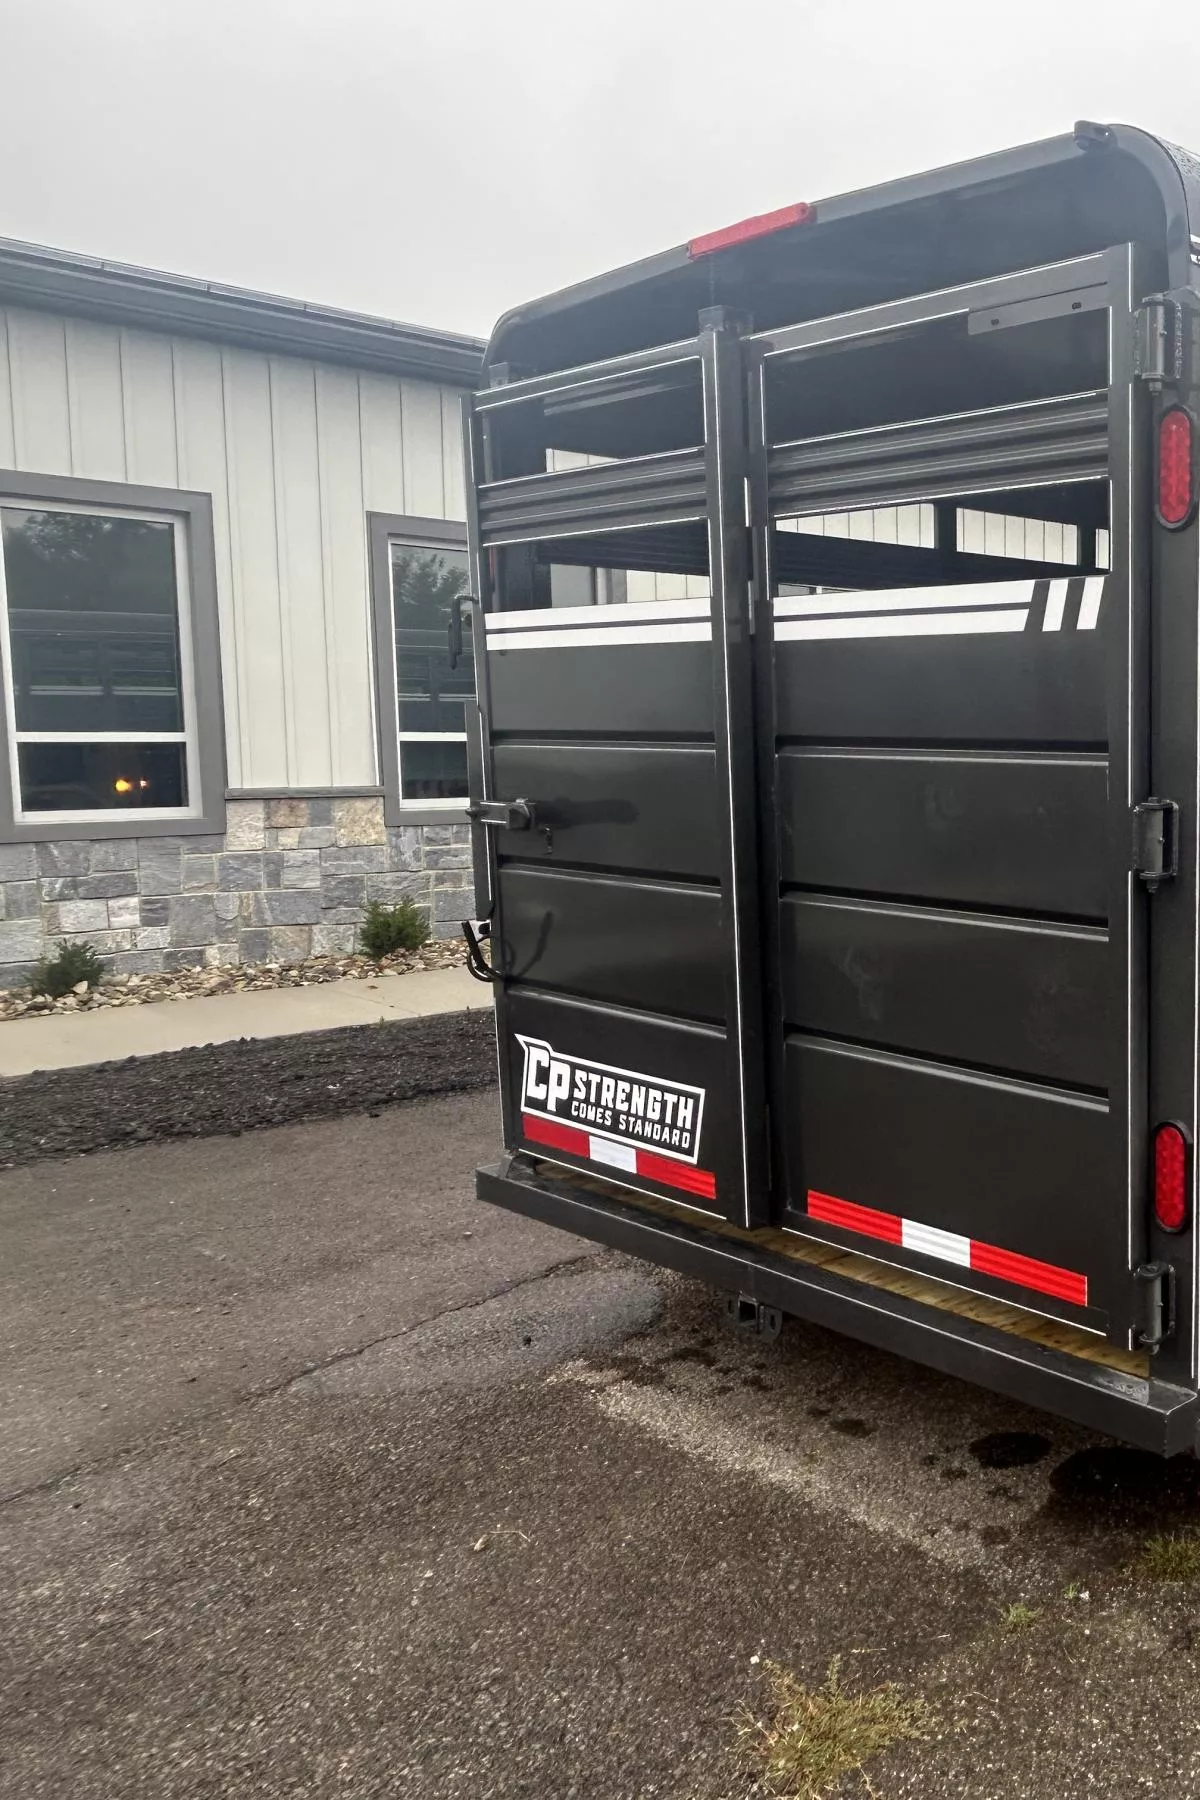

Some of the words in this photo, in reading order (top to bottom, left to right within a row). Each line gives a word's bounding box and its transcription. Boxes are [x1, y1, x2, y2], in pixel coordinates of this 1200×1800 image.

[526, 1045, 571, 1112] CP
[573, 1068, 694, 1130] STRENGTH
[571, 1101, 612, 1126] COMES
[619, 1115, 691, 1149] STANDARD
